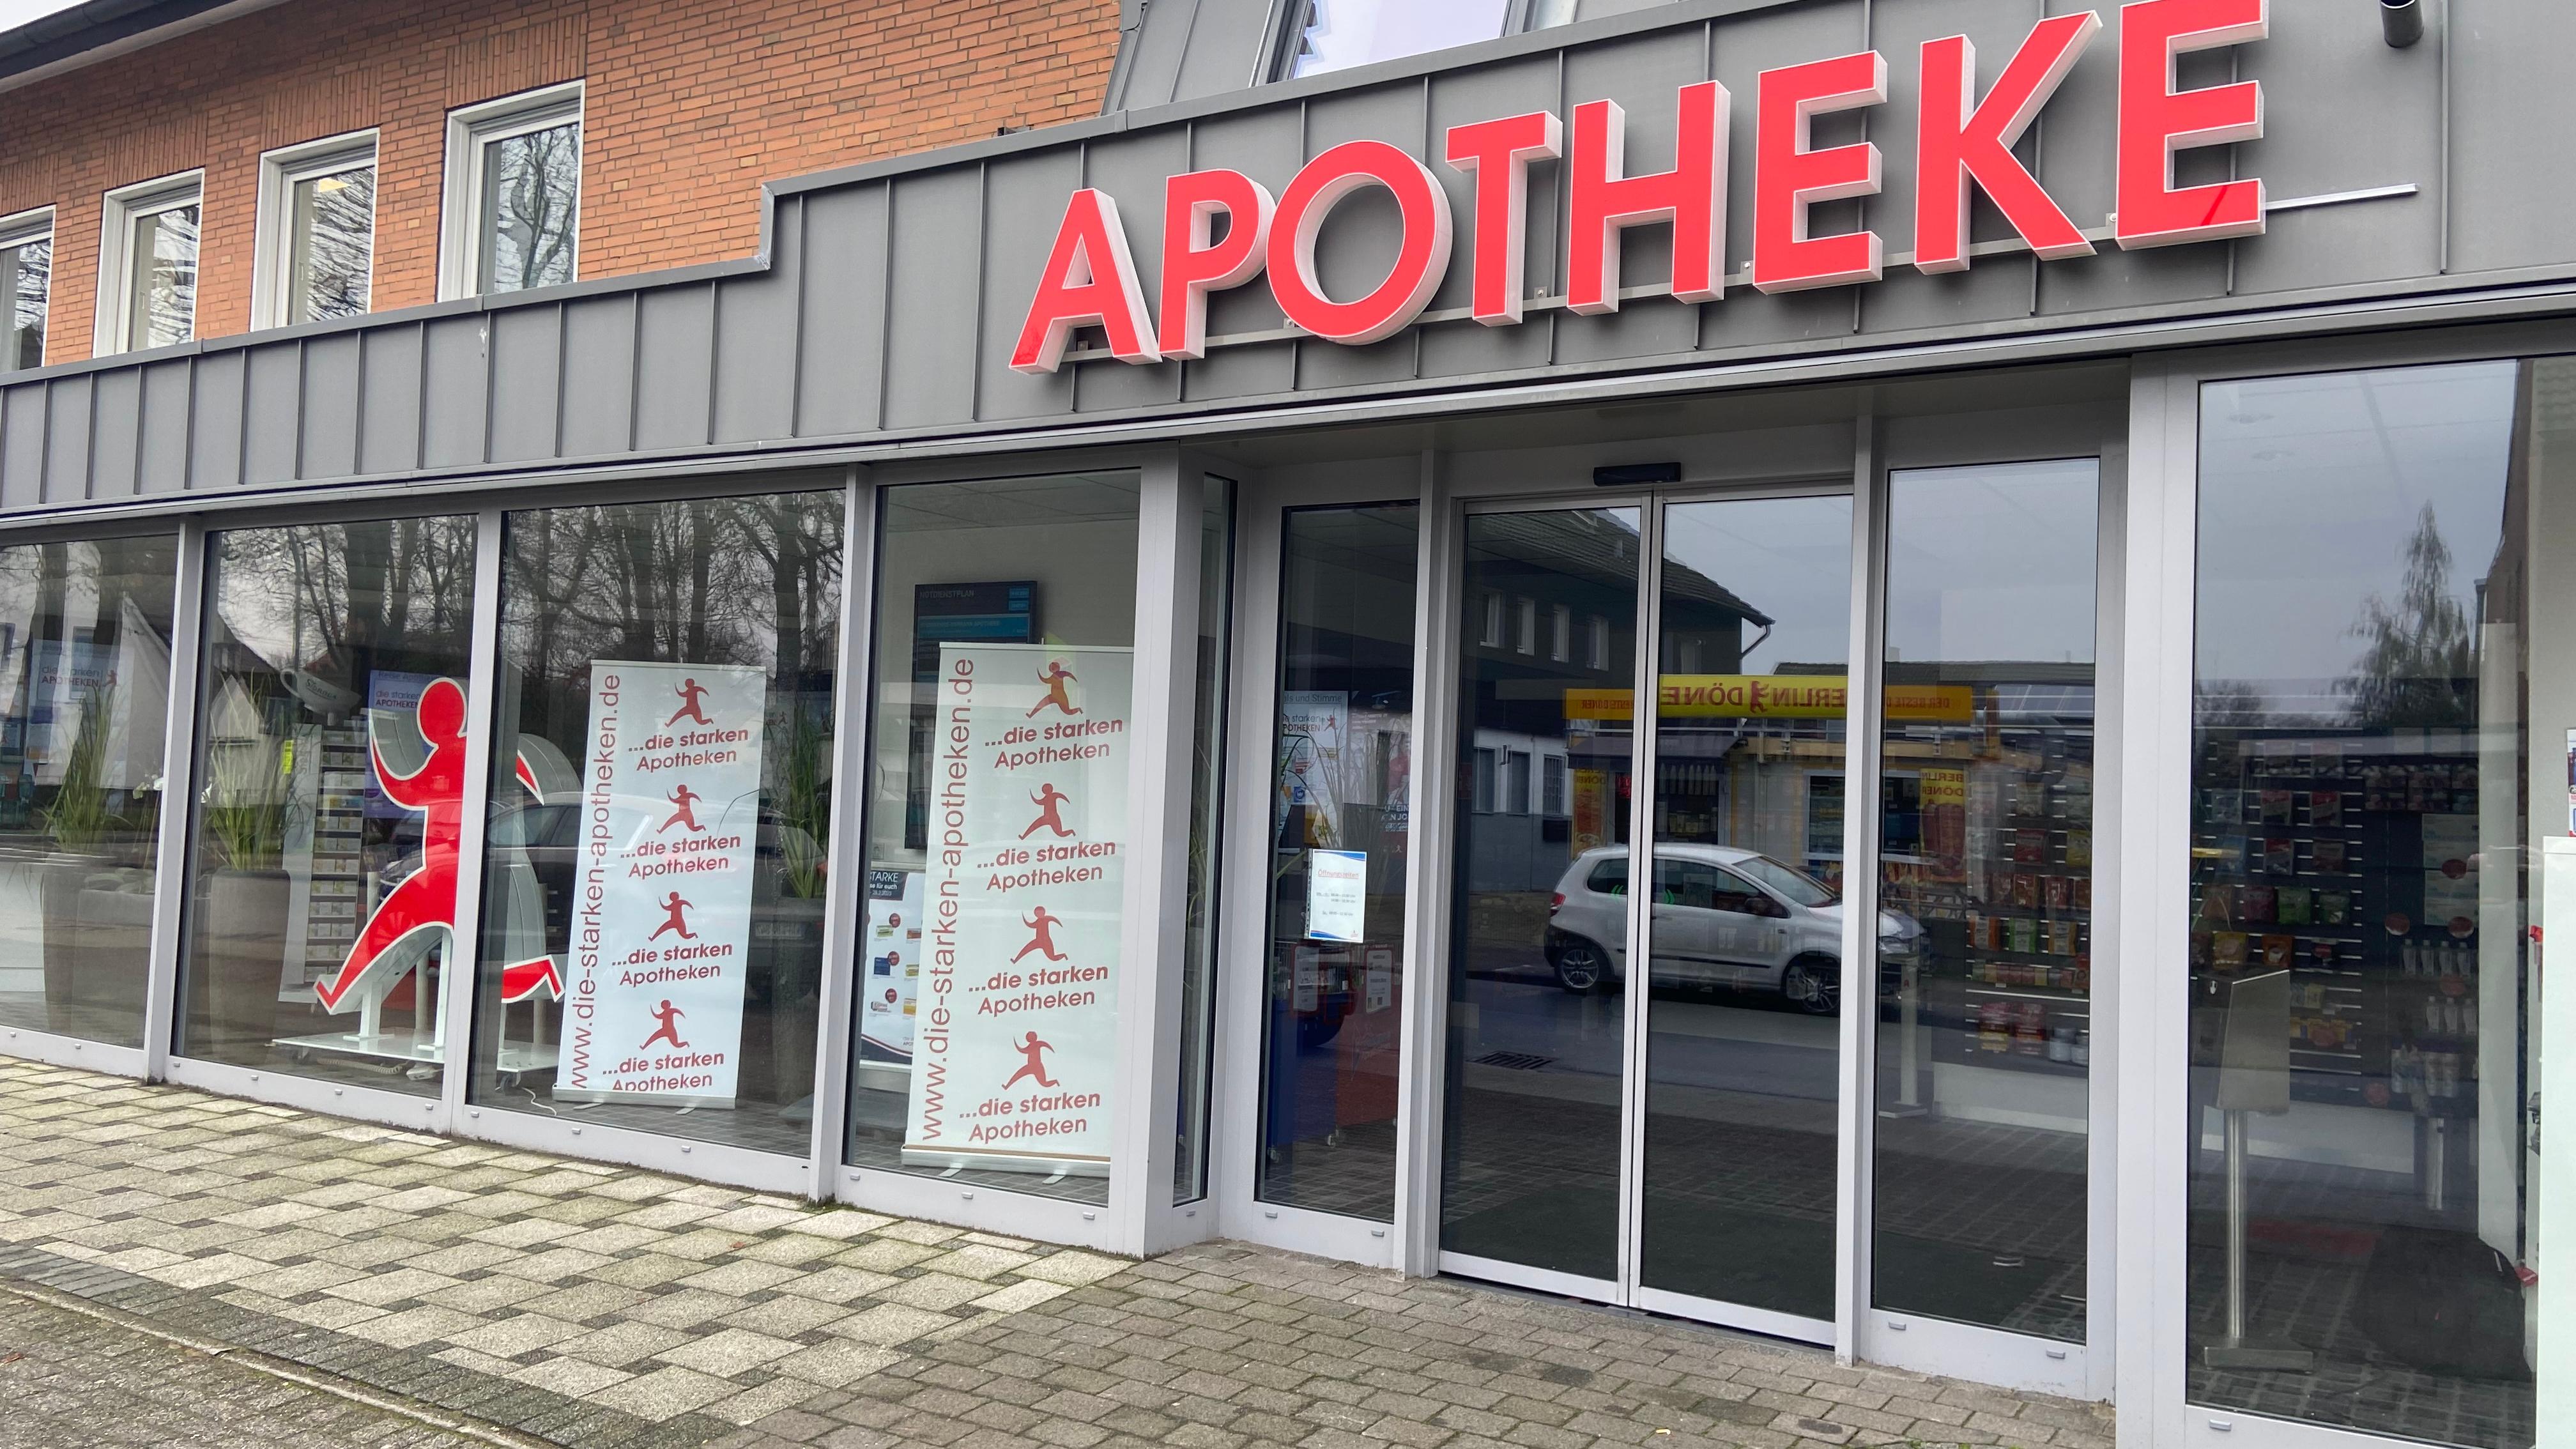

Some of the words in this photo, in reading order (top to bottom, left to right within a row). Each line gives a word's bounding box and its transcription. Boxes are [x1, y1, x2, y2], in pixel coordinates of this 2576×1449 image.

[1009, 0, 2269, 373] APOTHEKE
[41, 675, 99, 687] APOTHEKEN
[1312, 694, 1342, 703] Stimme
[680, 728, 748, 747] starken
[1044, 719, 1123, 740] starken
[636, 750, 737, 772] Apotheken
[994, 743, 1110, 770] Apotheken
[671, 836, 740, 854] starken
[1037, 841, 1116, 862] starken
[629, 857, 728, 880] Apotheken
[1318, 868, 1360, 879] Öffnungszeiten
[572, 674, 620, 1089] www.die-starken-apotheken.de
[986, 866, 1103, 893] Apotheken
[923, 659, 974, 1140] www.die-starken-apotheken.de
[664, 943, 732, 961] starken
[620, 965, 720, 988] Apotheken
[1029, 965, 1108, 986] starken
[978, 991, 1094, 1017] Apotheken
[655, 1052, 724, 1070] starken
[1020, 1092, 1100, 1112] starken
[969, 1117, 1086, 1144] Apotheken
